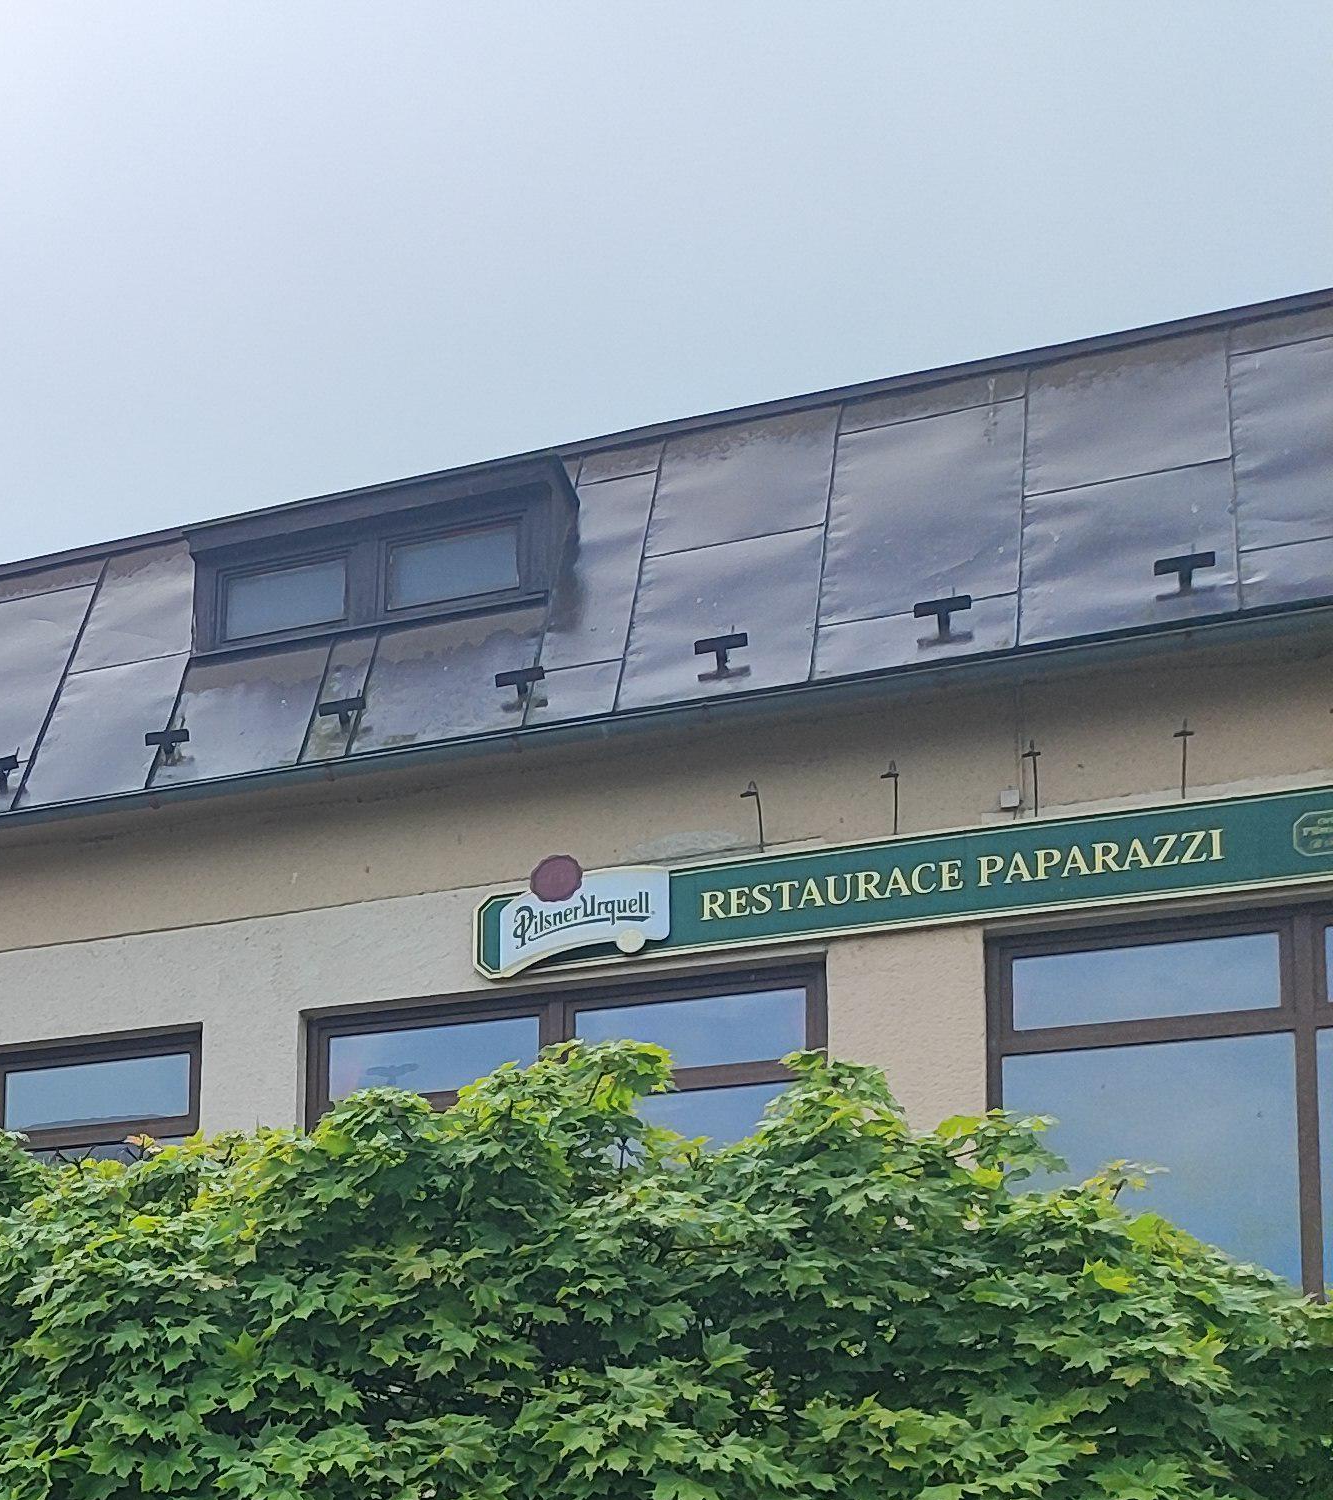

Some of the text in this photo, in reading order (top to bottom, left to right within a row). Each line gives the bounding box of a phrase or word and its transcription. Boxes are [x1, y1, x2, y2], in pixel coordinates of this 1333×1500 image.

[700, 828, 1225, 921] RESTAURACE PAPARAZZI
[512, 891, 650, 949] Pilsner Urquell
